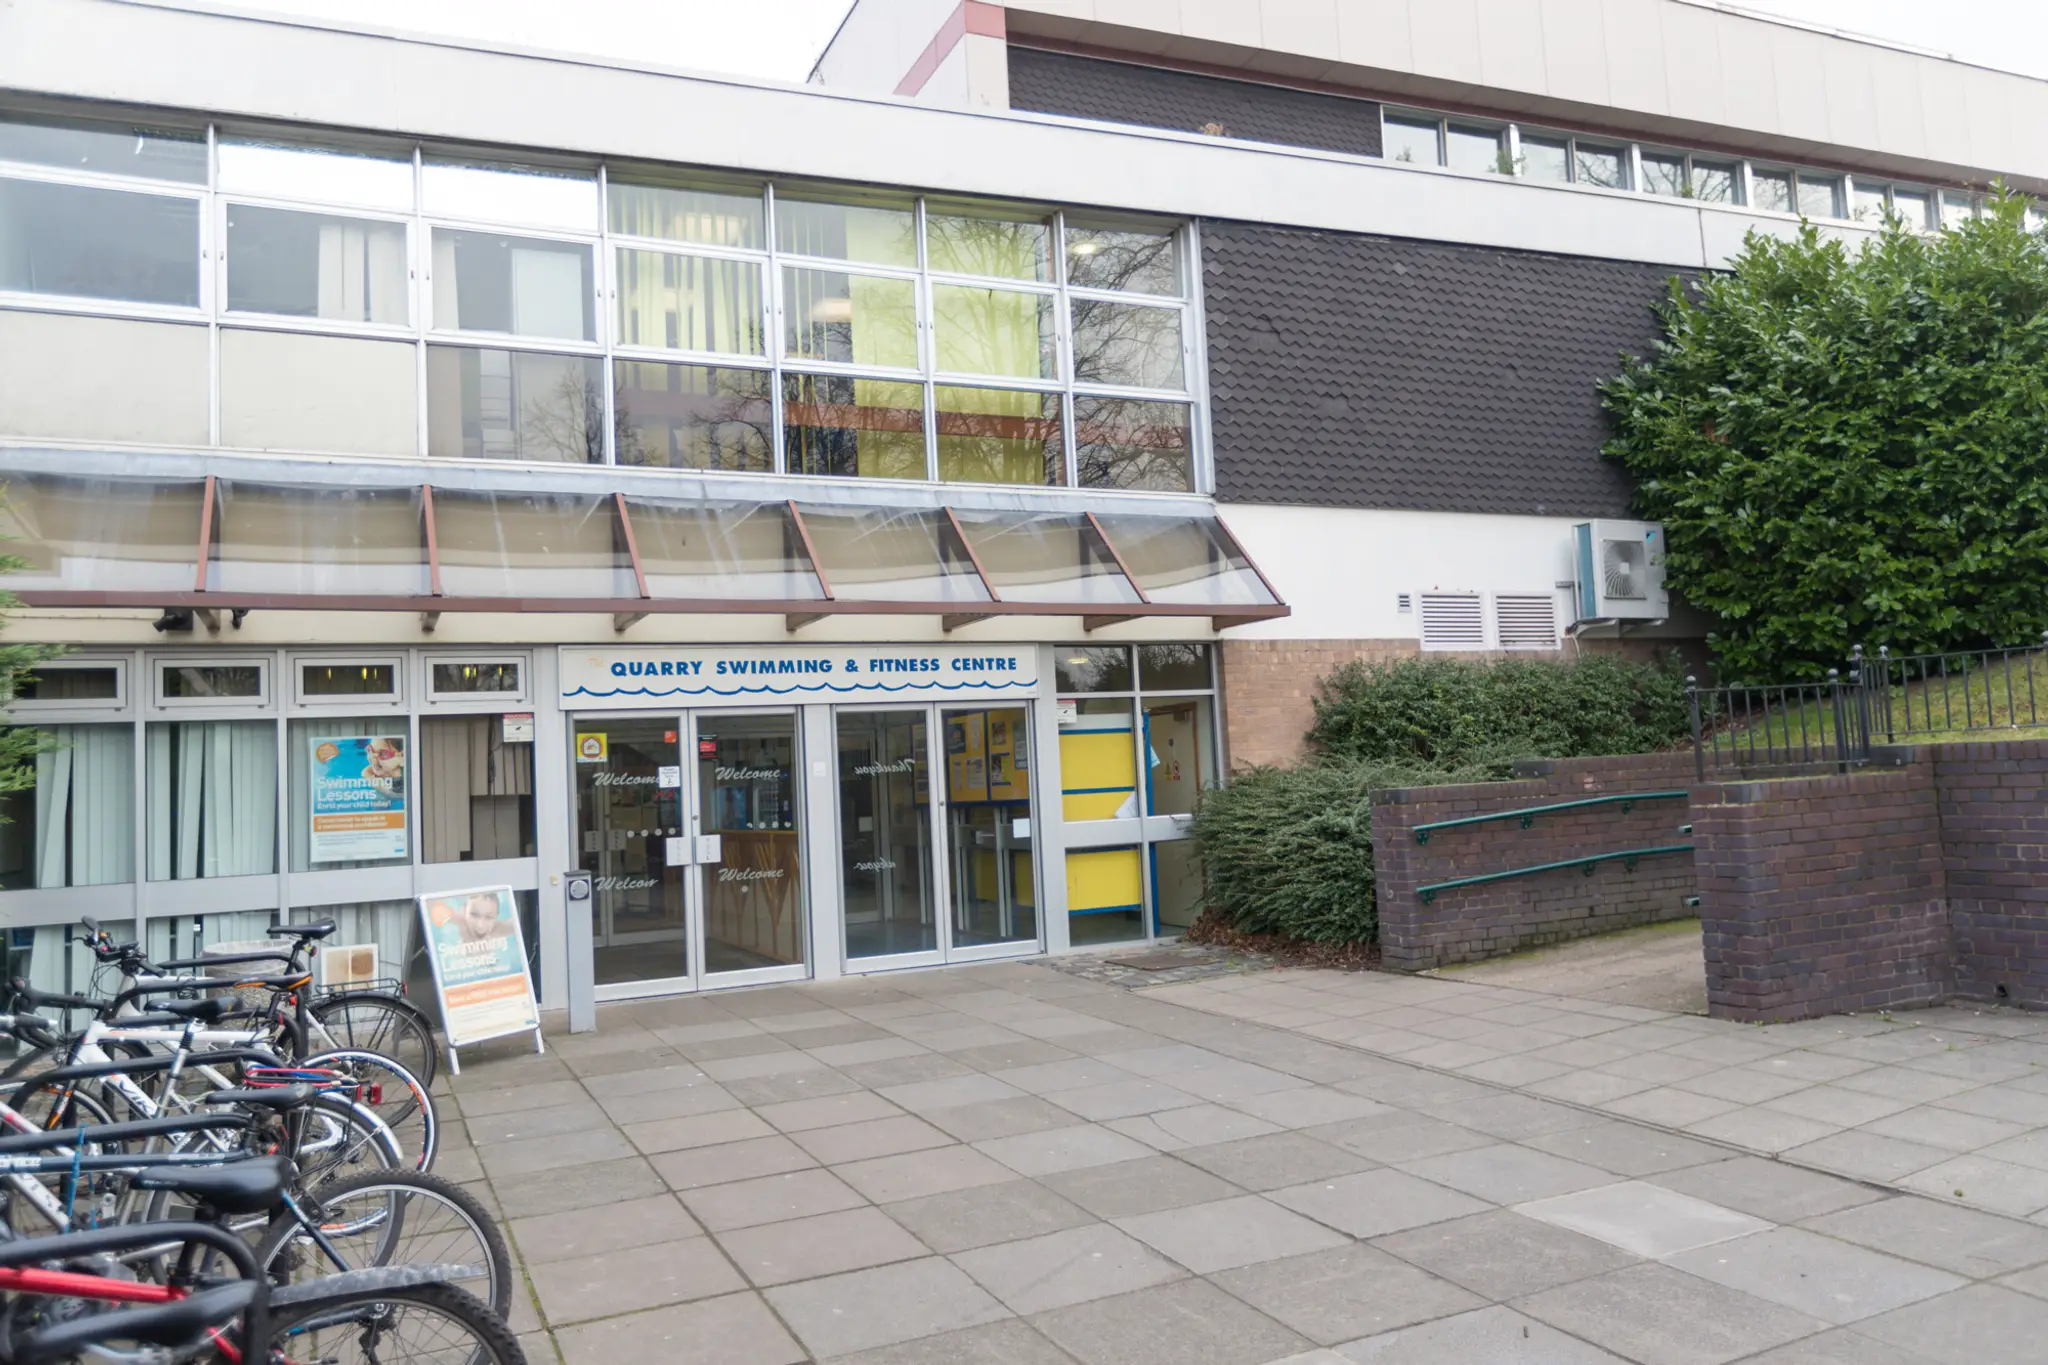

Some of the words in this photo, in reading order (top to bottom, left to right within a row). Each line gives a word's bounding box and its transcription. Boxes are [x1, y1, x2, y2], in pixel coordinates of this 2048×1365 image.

[611, 661, 703, 677] QUARRY
[716, 659, 833, 675] SWIMMING
[845, 659, 859, 673] &
[870, 658, 940, 672] FITNESS
[952, 657, 1016, 671] CENTRE
[715, 766, 781, 780] Welcome
[317, 776, 393, 789] Swimming
[317, 789, 377, 802] Lessons
[718, 867, 784, 881] Welcome
[437, 936, 508, 957] Swimming
[442, 952, 497, 972] Lessons
